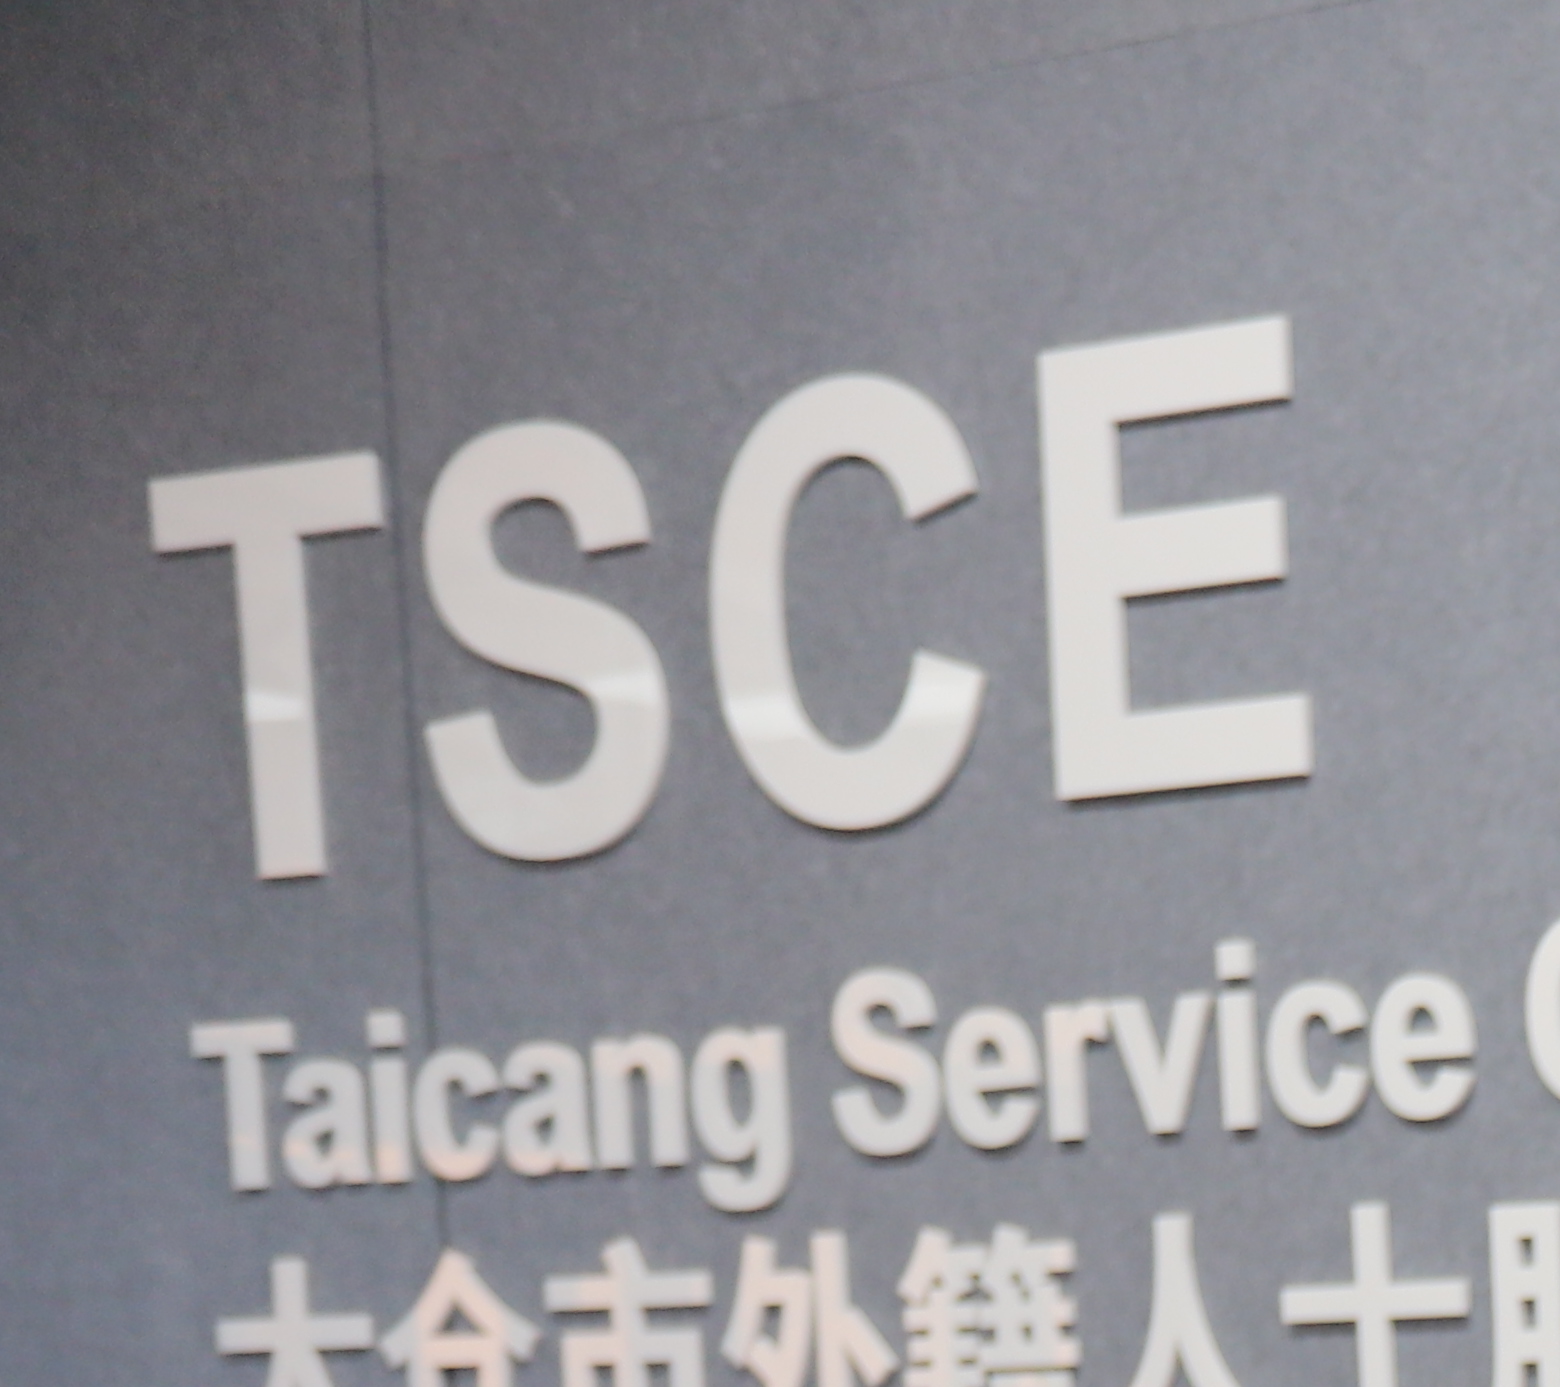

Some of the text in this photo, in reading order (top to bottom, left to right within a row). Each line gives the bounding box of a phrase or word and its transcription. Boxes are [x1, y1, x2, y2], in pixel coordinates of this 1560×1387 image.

[148, 314, 1313, 879] TSCE
[190, 1010, 788, 1213] Taicang
[829, 938, 1475, 1157] Service
